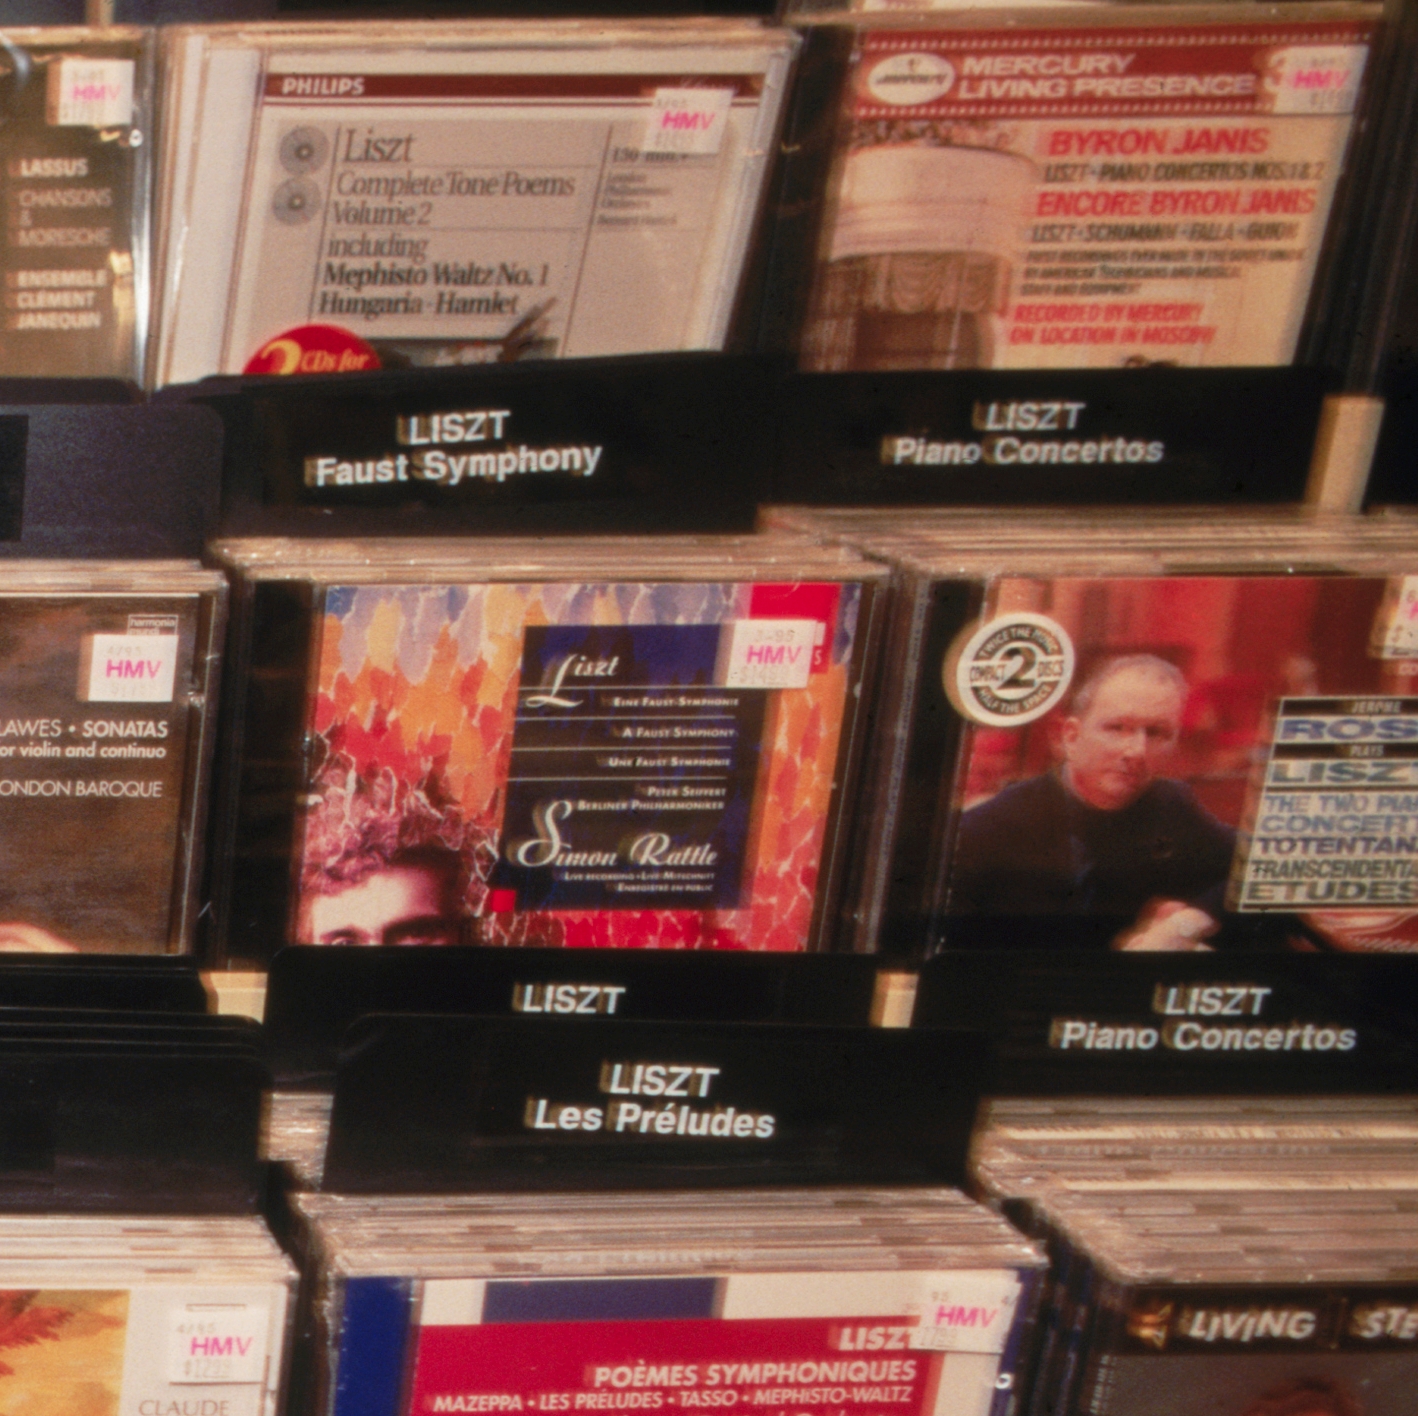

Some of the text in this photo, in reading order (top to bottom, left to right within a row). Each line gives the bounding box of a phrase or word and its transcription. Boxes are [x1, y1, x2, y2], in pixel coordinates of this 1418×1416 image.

[963, 53, 1135, 76] MERCURY
[282, 76, 364, 95] PHILIPS
[960, 74, 1255, 98] LIVING PRESENCE
[663, 111, 714, 130] HMV
[344, 129, 416, 164] Liszt
[1048, 127, 1270, 156] BYRON JANIS
[19, 159, 88, 177] LASSUS
[337, 170, 575, 199] Complete Tone Poems
[332, 202, 431, 226] Volume 2
[327, 233, 429, 263] including
[323, 262, 549, 292] Mephisto Waltz No. 1
[410, 411, 510, 445] LISZT
[986, 402, 1084, 429] LISZT
[894, 438, 1164, 464] Piano Concertos
[317, 446, 602, 485] Faust Symphony
[747, 645, 801, 664] HMV
[106, 659, 163, 679] HMV
[526, 652, 619, 707] Liszt
[83, 720, 168, 738] SONATAS
[20, 741, 61, 757] violin
[66, 742, 96, 757] and
[100, 742, 166, 758] continuo
[75, 779, 163, 798] BAROQUE
[518, 801, 717, 867] Simon Rattle
[523, 985, 624, 1015] LISZT
[1165, 988, 1271, 1015] LISZT
[1061, 1022, 1356, 1051] Piano Concertos
[610, 1065, 719, 1098] LISZT
[535, 1101, 774, 1138] Les Préludes
[935, 1306, 997, 1327] HMV
[1189, 1312, 1316, 1341] LIVING
[190, 1336, 252, 1358] HMV
[594, 1360, 916, 1388] POÈMES SYMPHONIQUES
